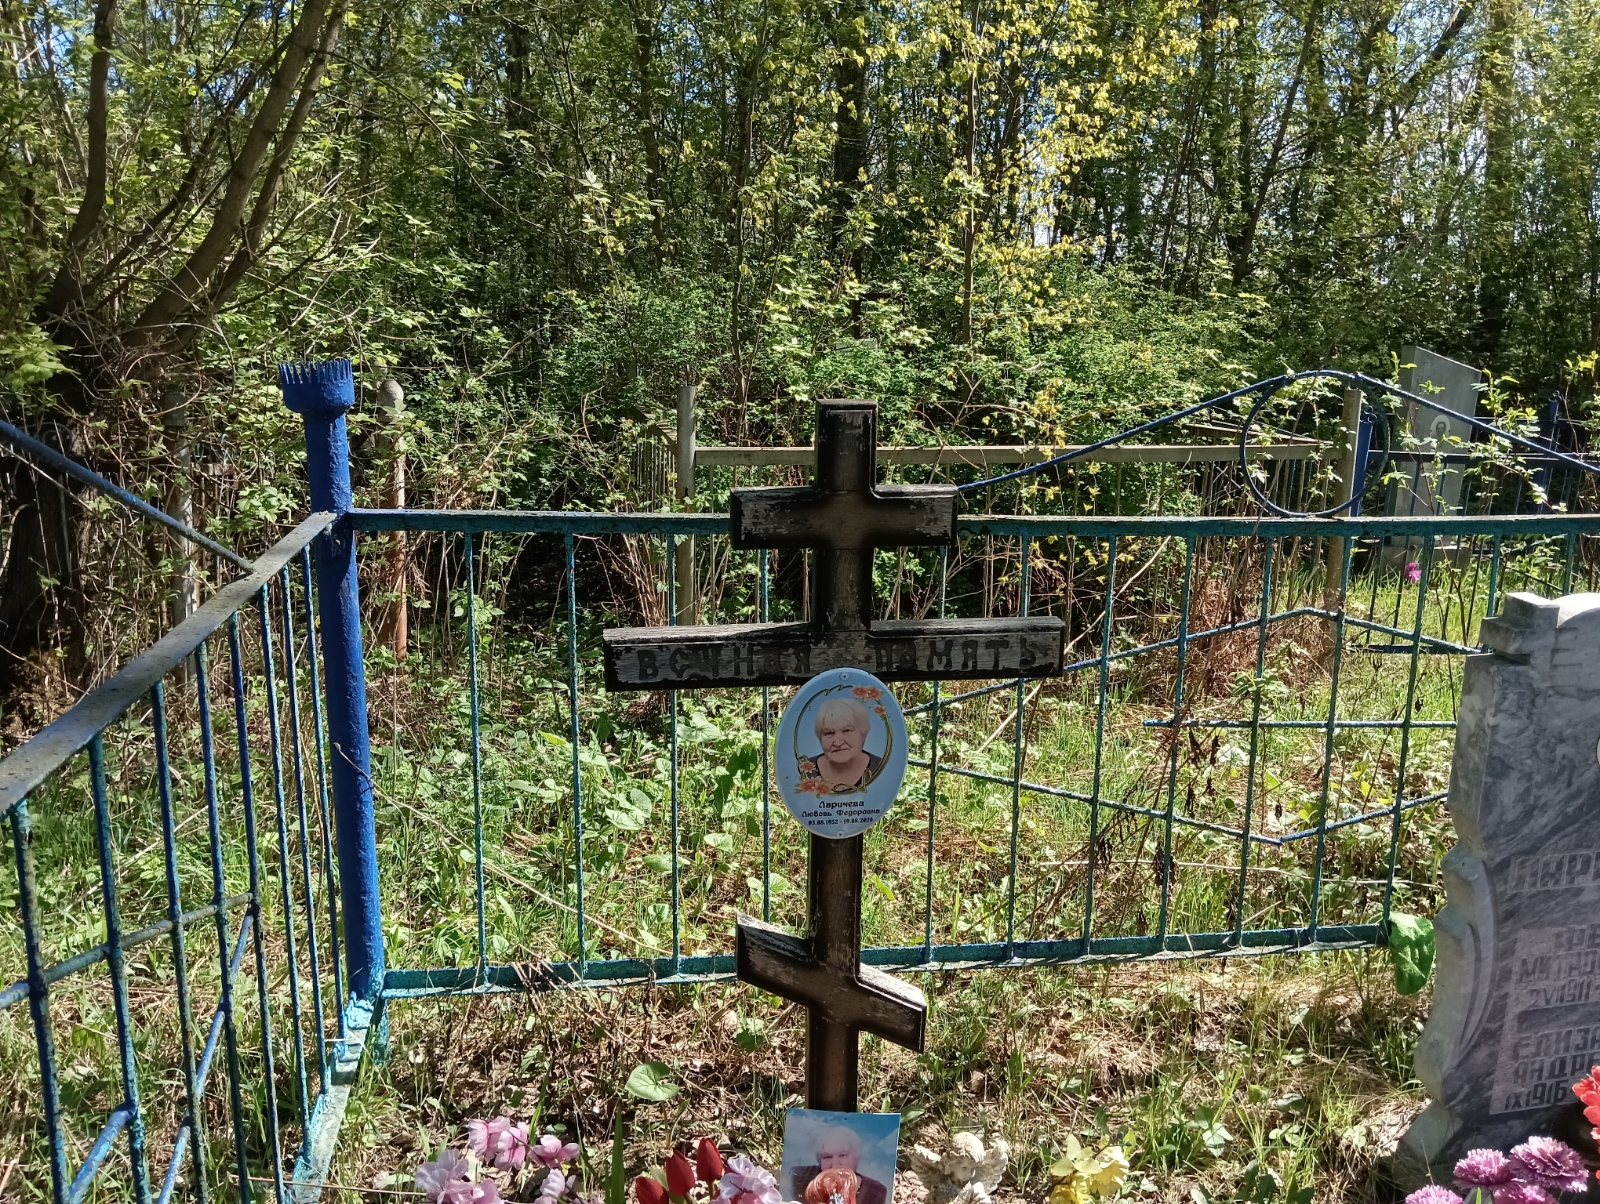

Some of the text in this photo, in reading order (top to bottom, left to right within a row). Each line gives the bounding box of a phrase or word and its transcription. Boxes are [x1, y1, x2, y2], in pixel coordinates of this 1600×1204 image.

[819, 801, 864, 810] Ларичева
[801, 808, 880, 818] Любовь Федоровна
[1515, 950, 1600, 983] МИТРО
